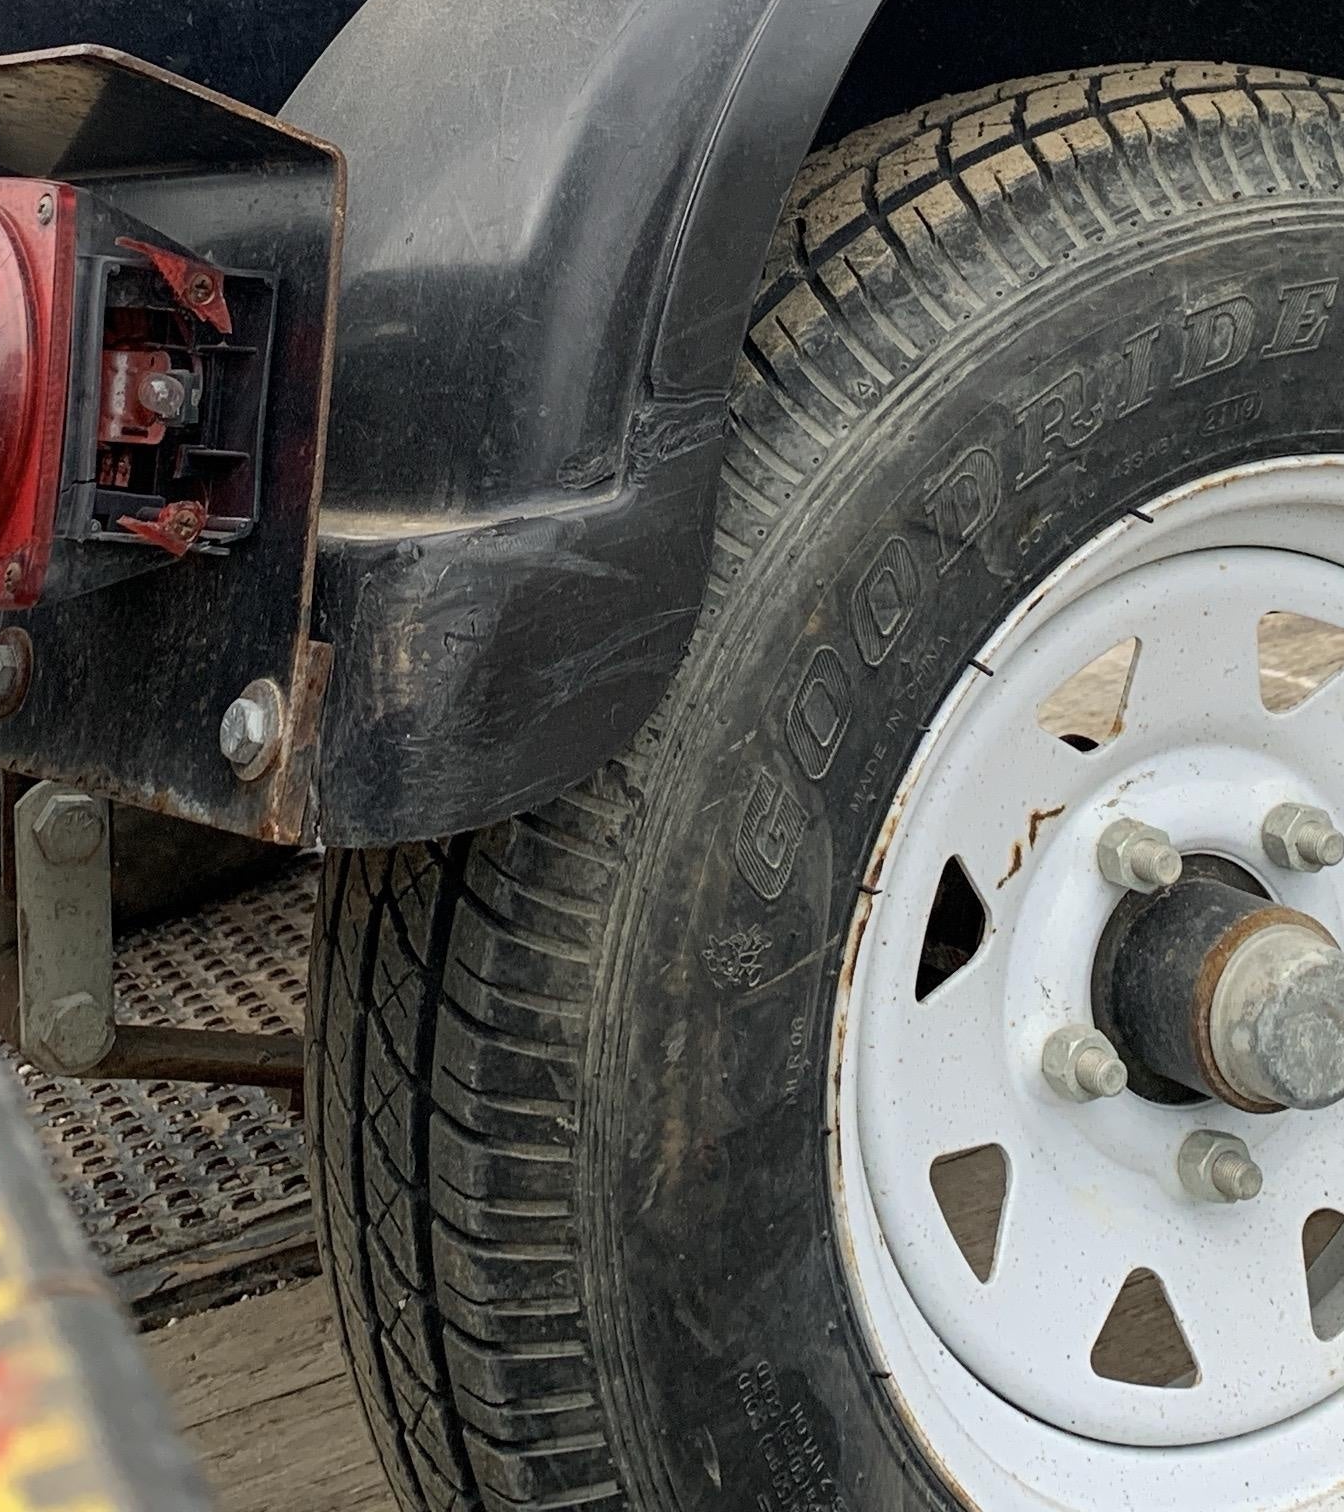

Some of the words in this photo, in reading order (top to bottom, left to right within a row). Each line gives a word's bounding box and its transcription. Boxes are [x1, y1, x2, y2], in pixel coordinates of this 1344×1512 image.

[734, 276, 1340, 901] GOODRIDE
[849, 740, 887, 814] MADE
[885, 707, 905, 735] IN
[906, 635, 952, 700] CHINA
